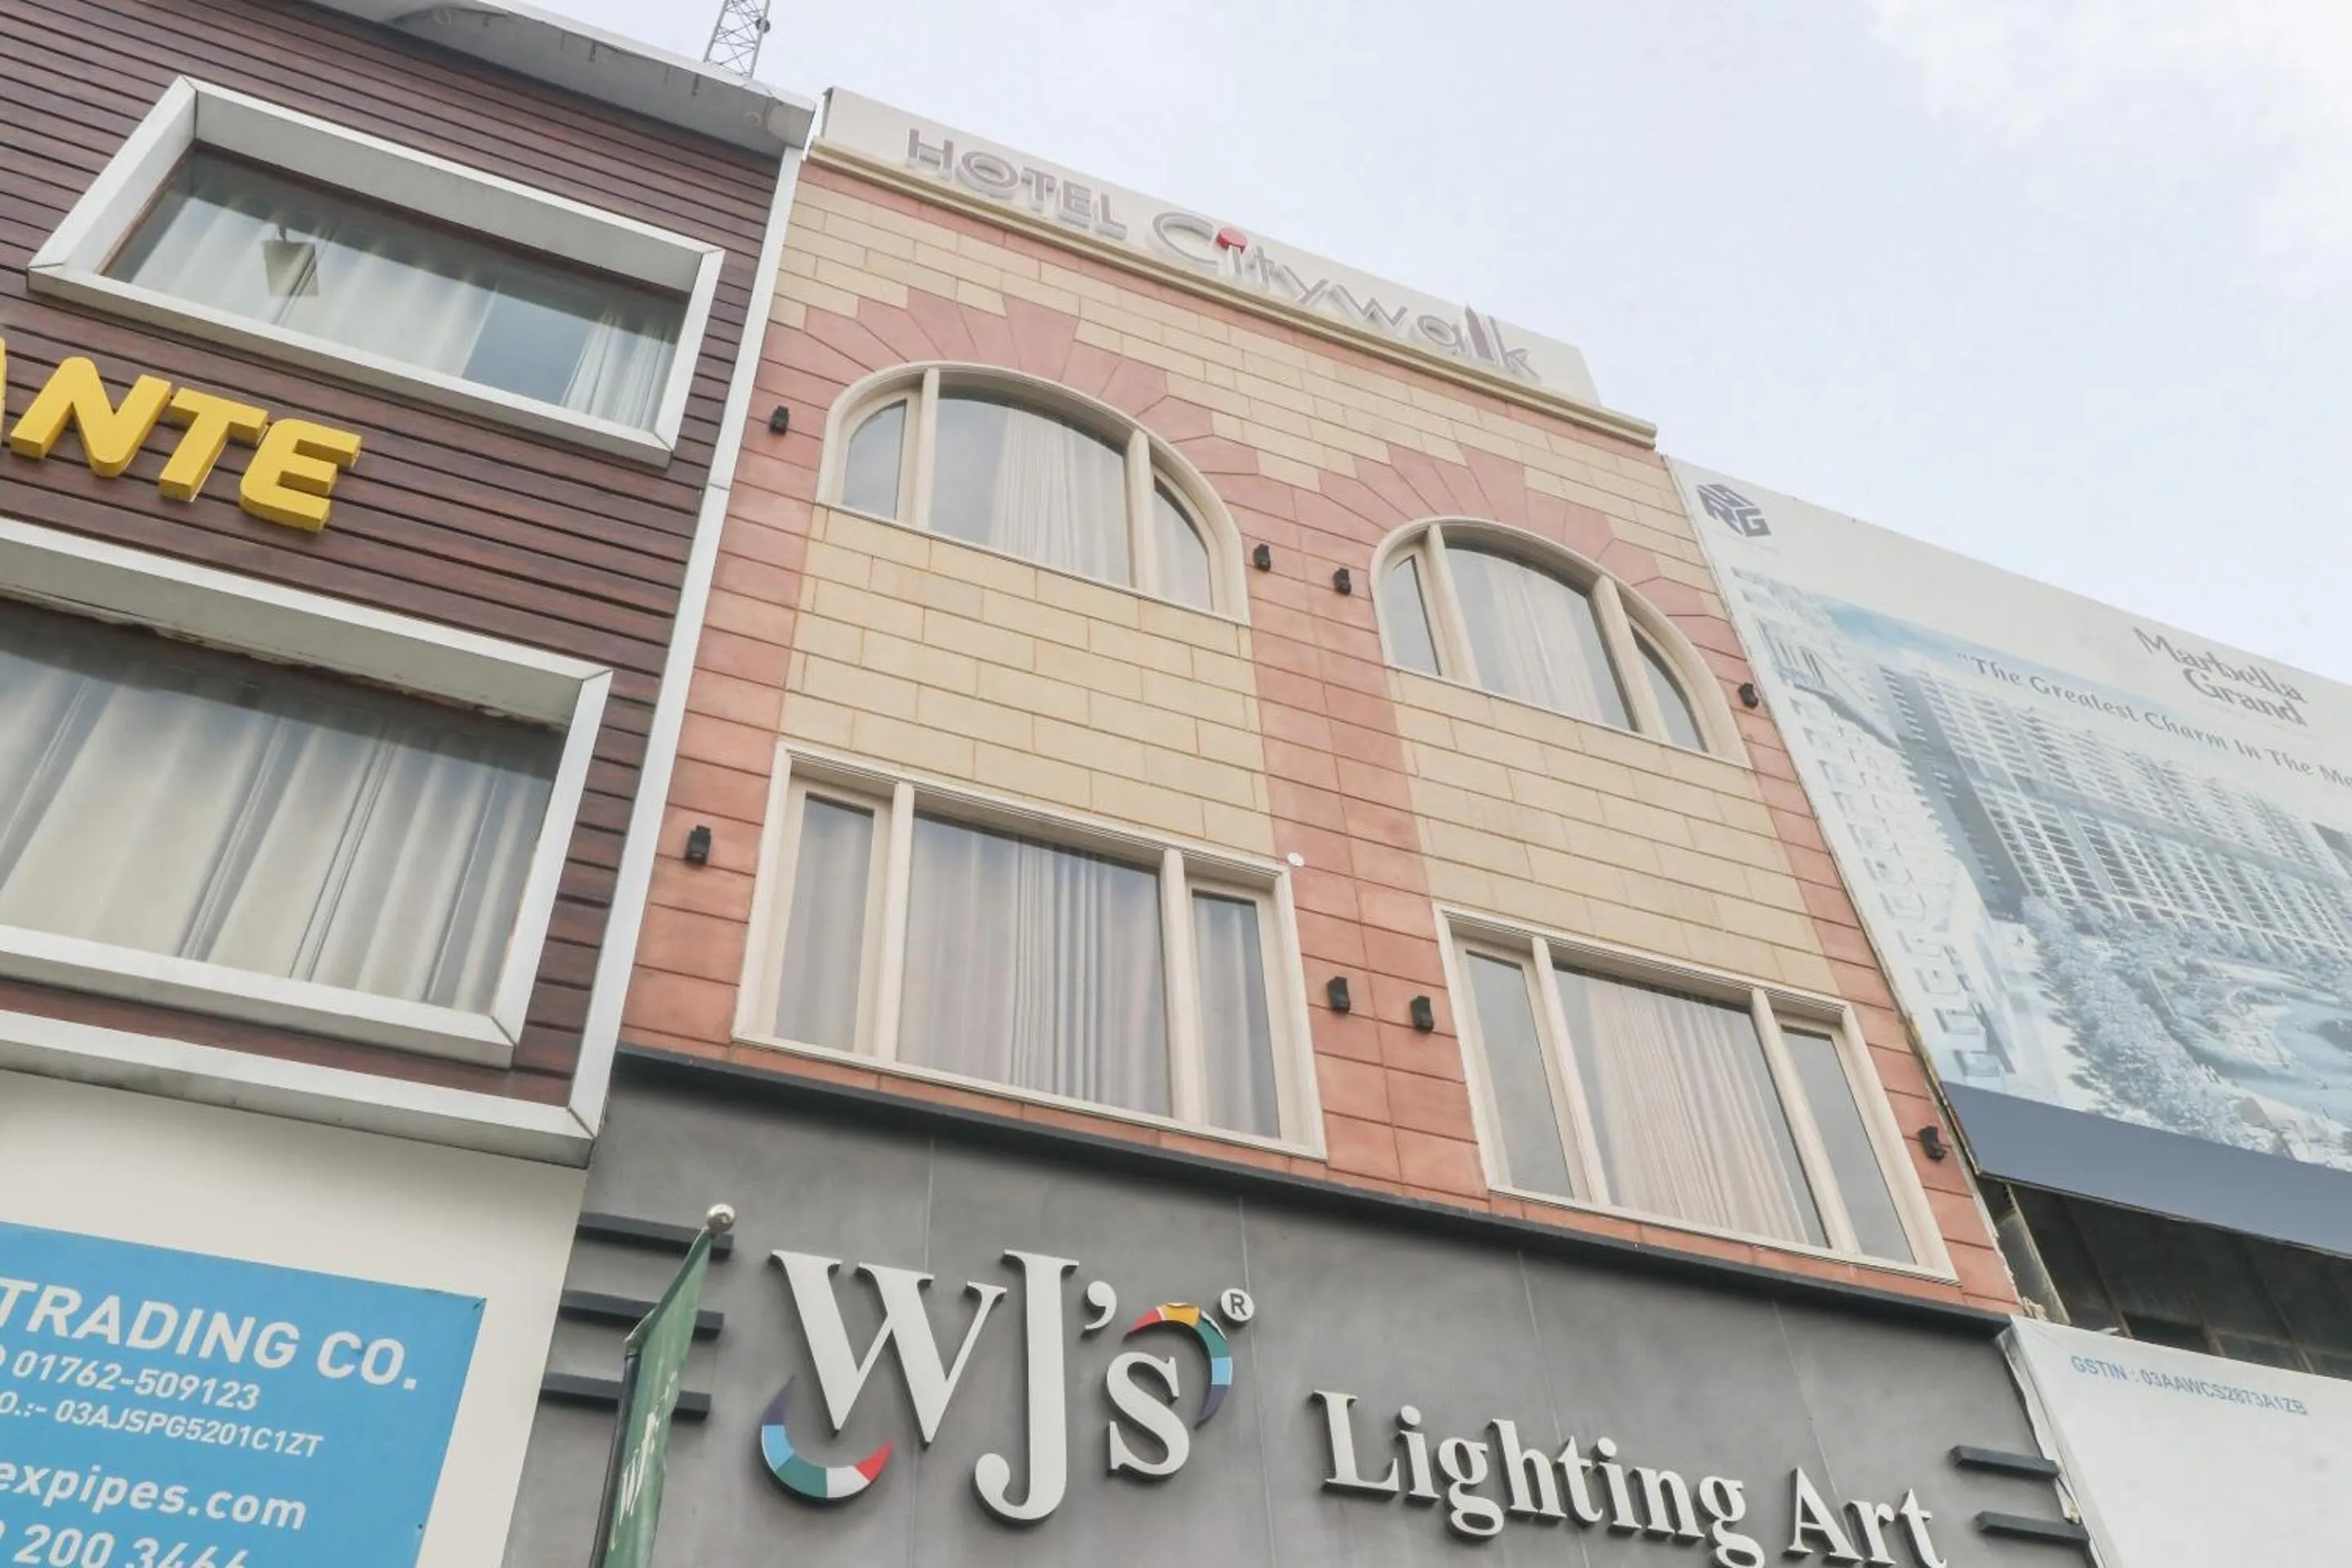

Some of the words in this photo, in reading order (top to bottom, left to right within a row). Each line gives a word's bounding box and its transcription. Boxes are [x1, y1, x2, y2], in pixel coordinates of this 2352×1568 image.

[906, 128, 1128, 241] HOTEL
[1145, 212, 1540, 379] Citywalk
[0, 336, 363, 532] NTE
[2133, 626, 2308, 704] Marbella
[2183, 667, 2308, 726] Grand
[2029, 676, 2139, 723] Greatest
[2144, 712, 2228, 751] Charm
[2234, 738, 2262, 761] In
[2265, 748, 2313, 777] The
[0, 1277, 301, 1369] TRADING
[317, 1331, 417, 1390] CO.
[2071, 1356, 2127, 1381] GSTIN
[12, 1350, 261, 1410] 01762-509123
[55, 1399, 323, 1458] 03AJSPG5201C1ZT
[0, 1462, 306, 1530] expipes.com
[1310, 1390, 1765, 1568] Lighting
[1783, 1465, 1947, 1568] Art
[13, 1524, 114, 1568] 200
